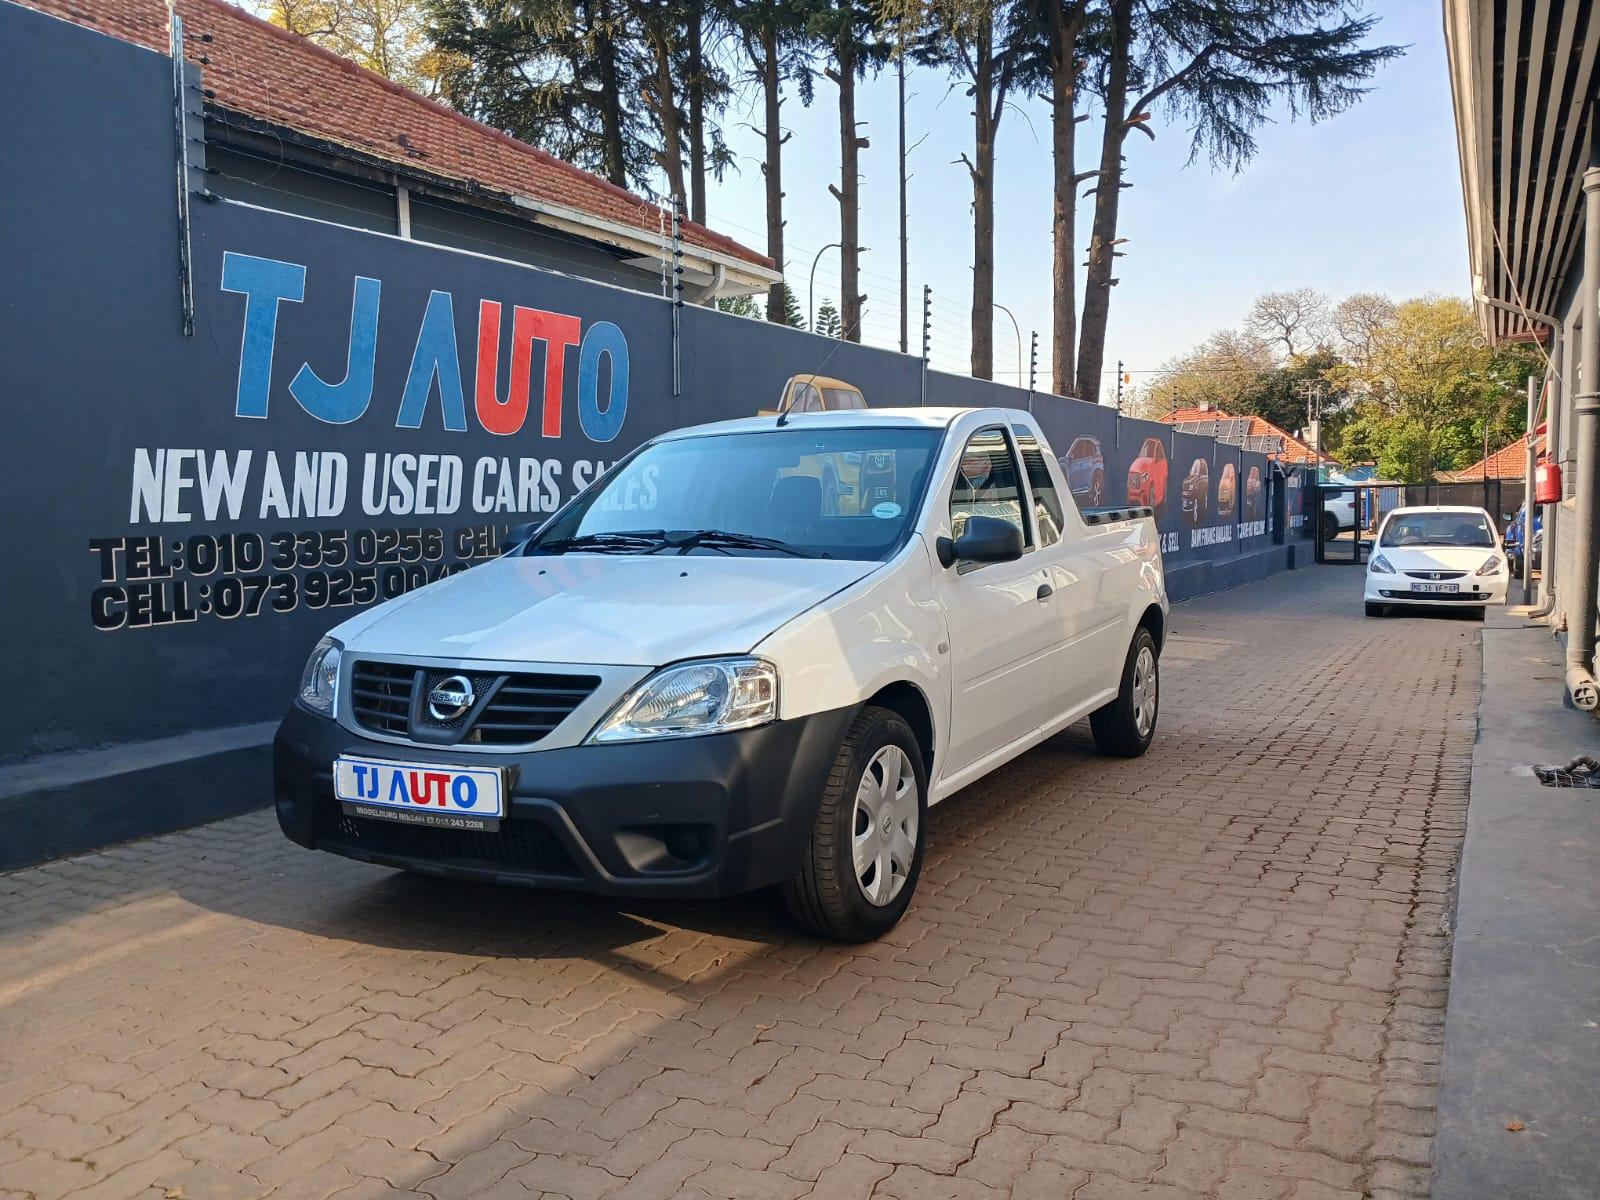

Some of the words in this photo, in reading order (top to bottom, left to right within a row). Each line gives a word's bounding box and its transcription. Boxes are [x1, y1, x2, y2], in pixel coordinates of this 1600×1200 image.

[221, 251, 381, 424] TJ
[395, 289, 630, 442] AUTO
[130, 448, 252, 523] NEW
[259, 451, 348, 519] AND
[362, 453, 463, 515] USED
[472, 456, 562, 513] CARS
[270, 529, 348, 570] 335
[354, 526, 444, 569] 0256
[1168, 531, 1179, 552] SELL
[304, 568, 377, 609] 925
[430, 692, 470, 705] NISSAN
[352, 765, 379, 799] TJ
[389, 770, 478, 809] AUTO
[450, 818, 464, 827] 243
